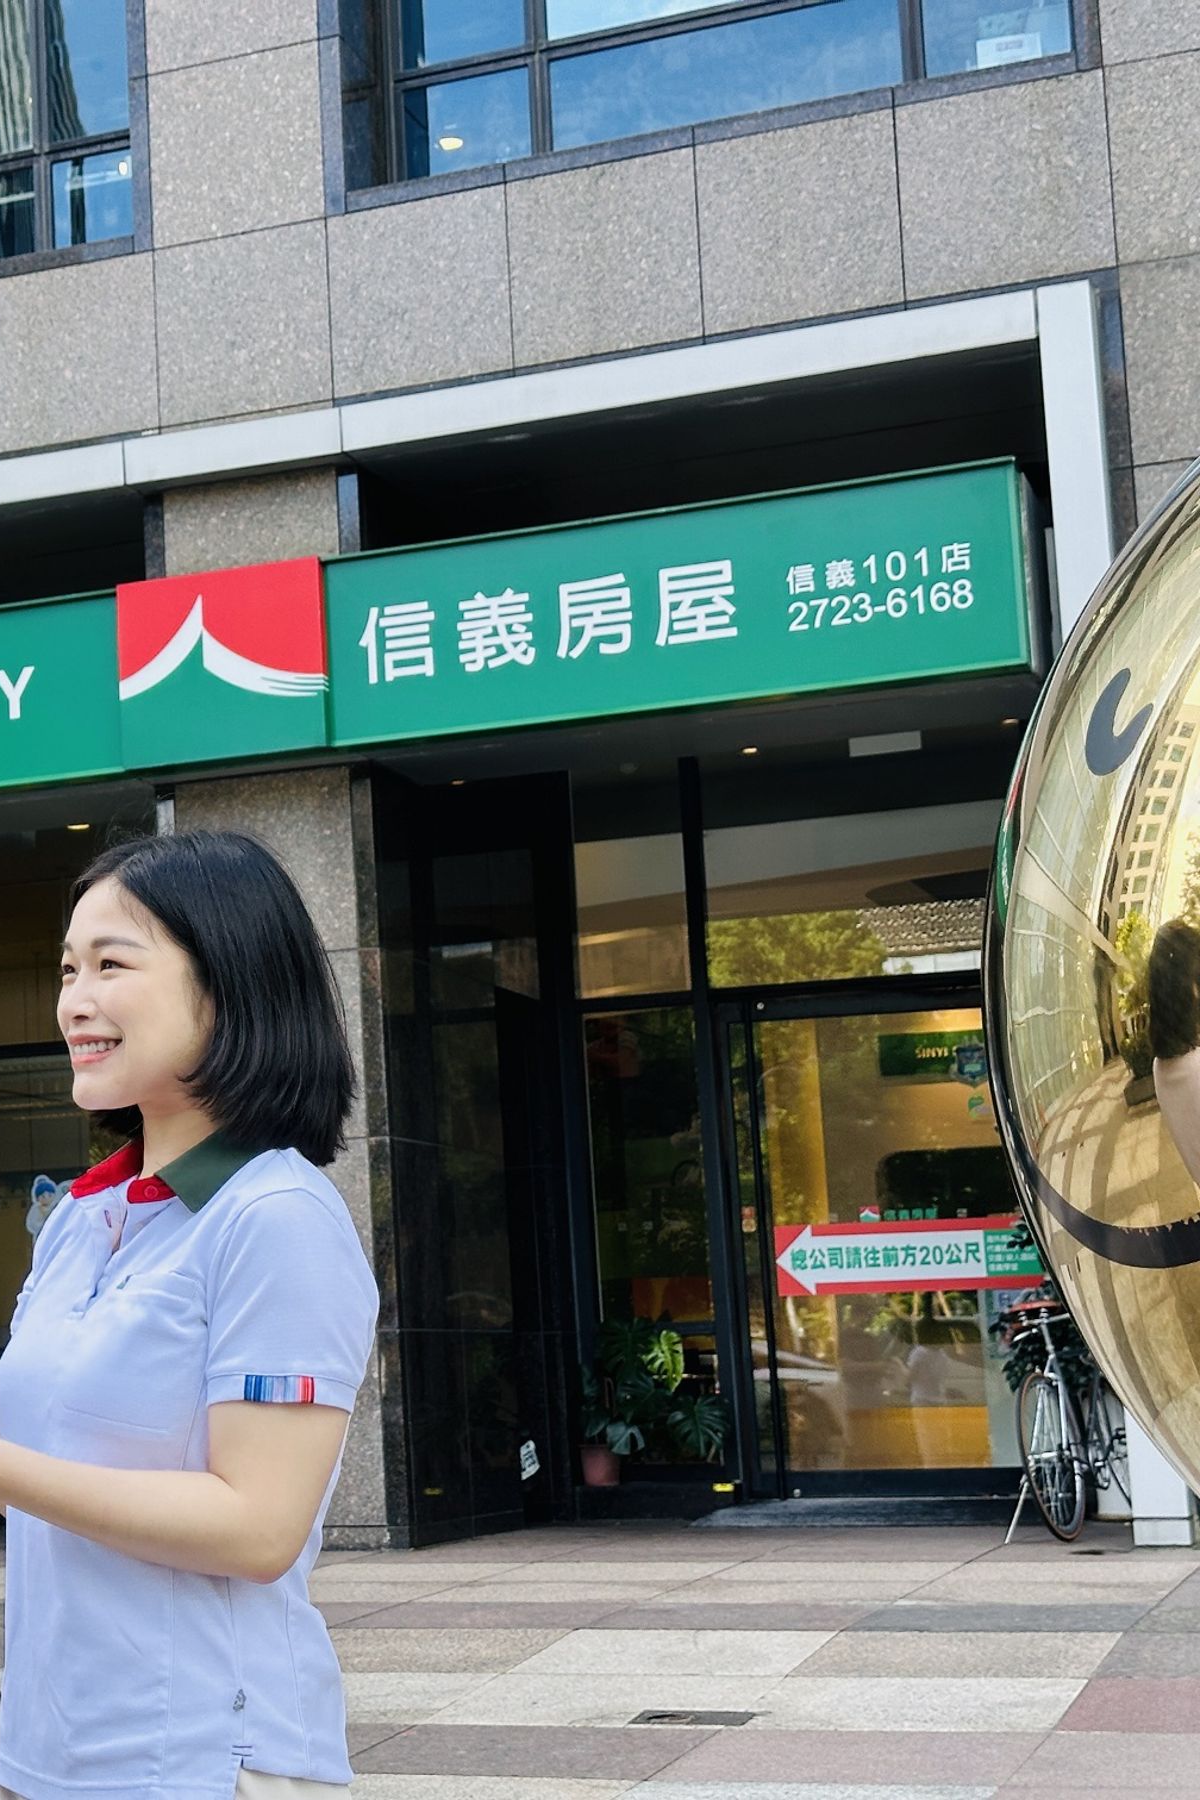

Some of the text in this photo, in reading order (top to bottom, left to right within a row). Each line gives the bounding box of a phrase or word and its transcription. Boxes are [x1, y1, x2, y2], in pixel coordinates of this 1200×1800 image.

[786, 542, 971, 595] 信義101店
[358, 559, 738, 685] 信義房屋
[788, 579, 974, 632] 2723-6168
[791, 1242, 981, 1270] 總公司請往前方20公尺
